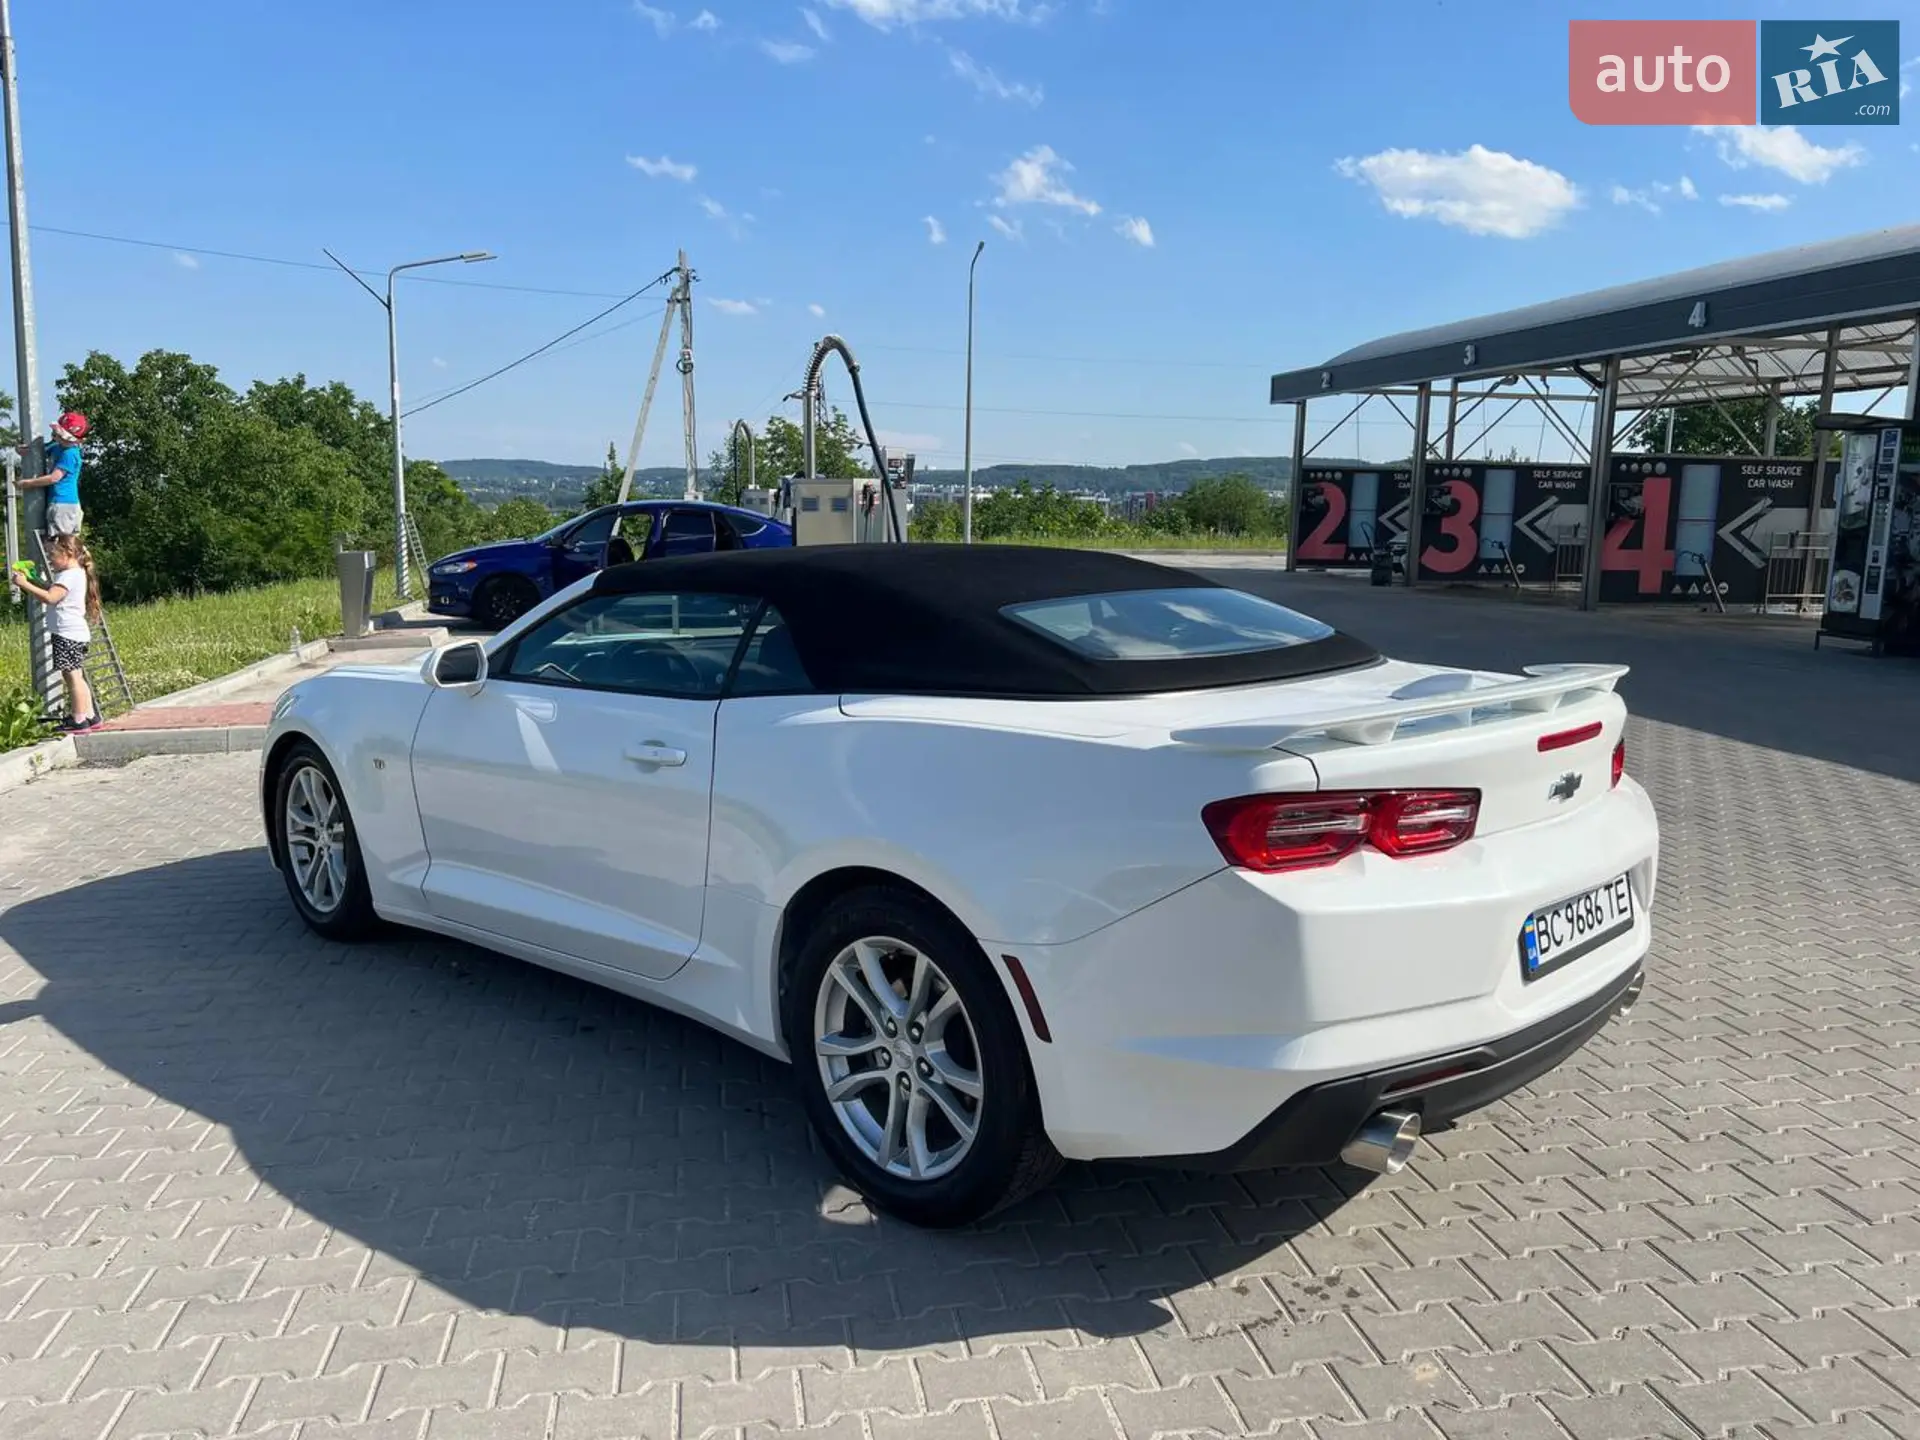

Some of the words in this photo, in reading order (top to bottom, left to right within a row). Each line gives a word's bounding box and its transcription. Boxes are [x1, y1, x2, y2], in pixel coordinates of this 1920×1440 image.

[1688, 301, 1706, 328] 4
[1463, 344, 1476, 365] 3
[1320, 371, 1332, 389] 2
[1533, 470, 1550, 478] SELF
[1553, 470, 1583, 479] SERVICE
[1741, 465, 1764, 475] SELF
[1766, 466, 1803, 476] SERVICE
[1538, 480, 1553, 489] CAR
[1748, 478, 1766, 488] CAR
[1767, 479, 1794, 489] WASH
[1296, 481, 1347, 560] 2
[1420, 480, 1480, 573] 3
[1601, 477, 1676, 593] 4
[1536, 909, 1564, 955] BC
[1565, 888, 1604, 940] 9686
[1603, 877, 1629, 919] TE
